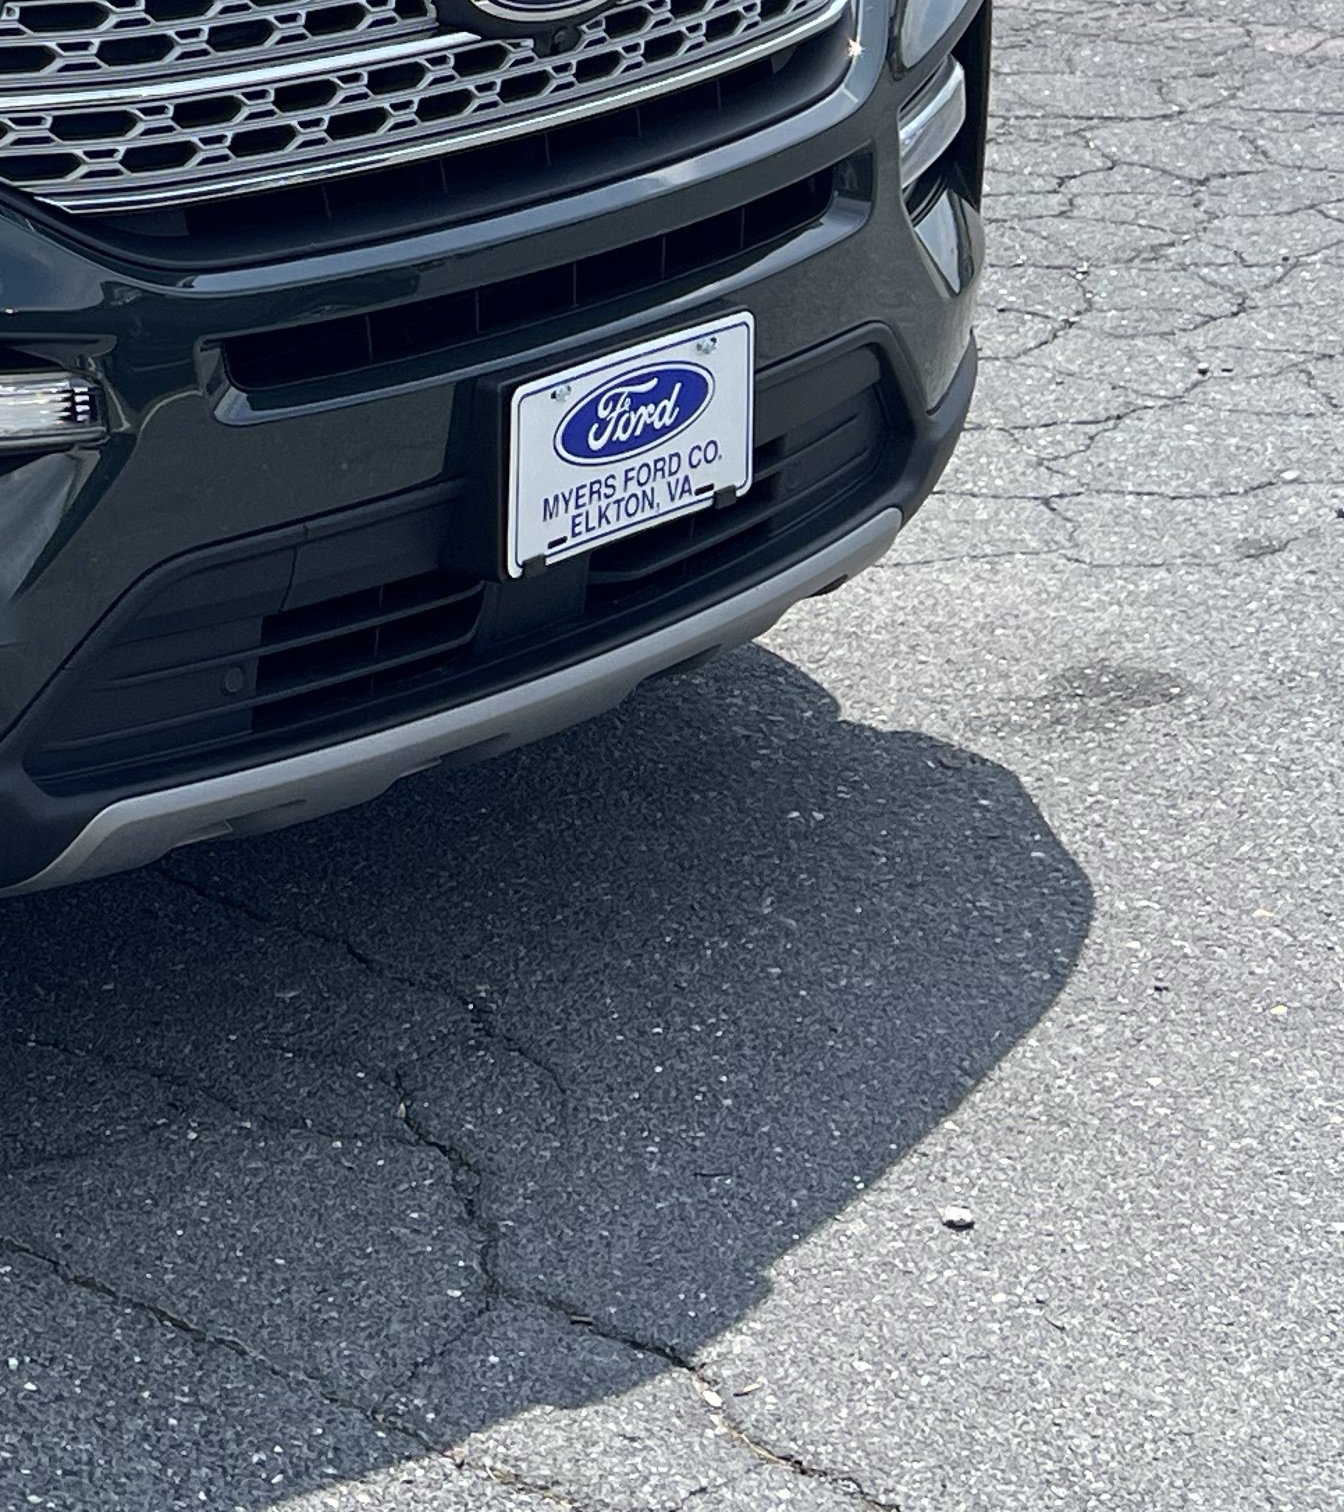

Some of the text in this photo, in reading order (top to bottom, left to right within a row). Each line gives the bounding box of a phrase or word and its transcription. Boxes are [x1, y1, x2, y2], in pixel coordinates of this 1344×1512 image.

[588, 378, 682, 451] Ford
[543, 439, 723, 522] MYERS FORD CO.
[571, 487, 661, 537] ELKTON,
